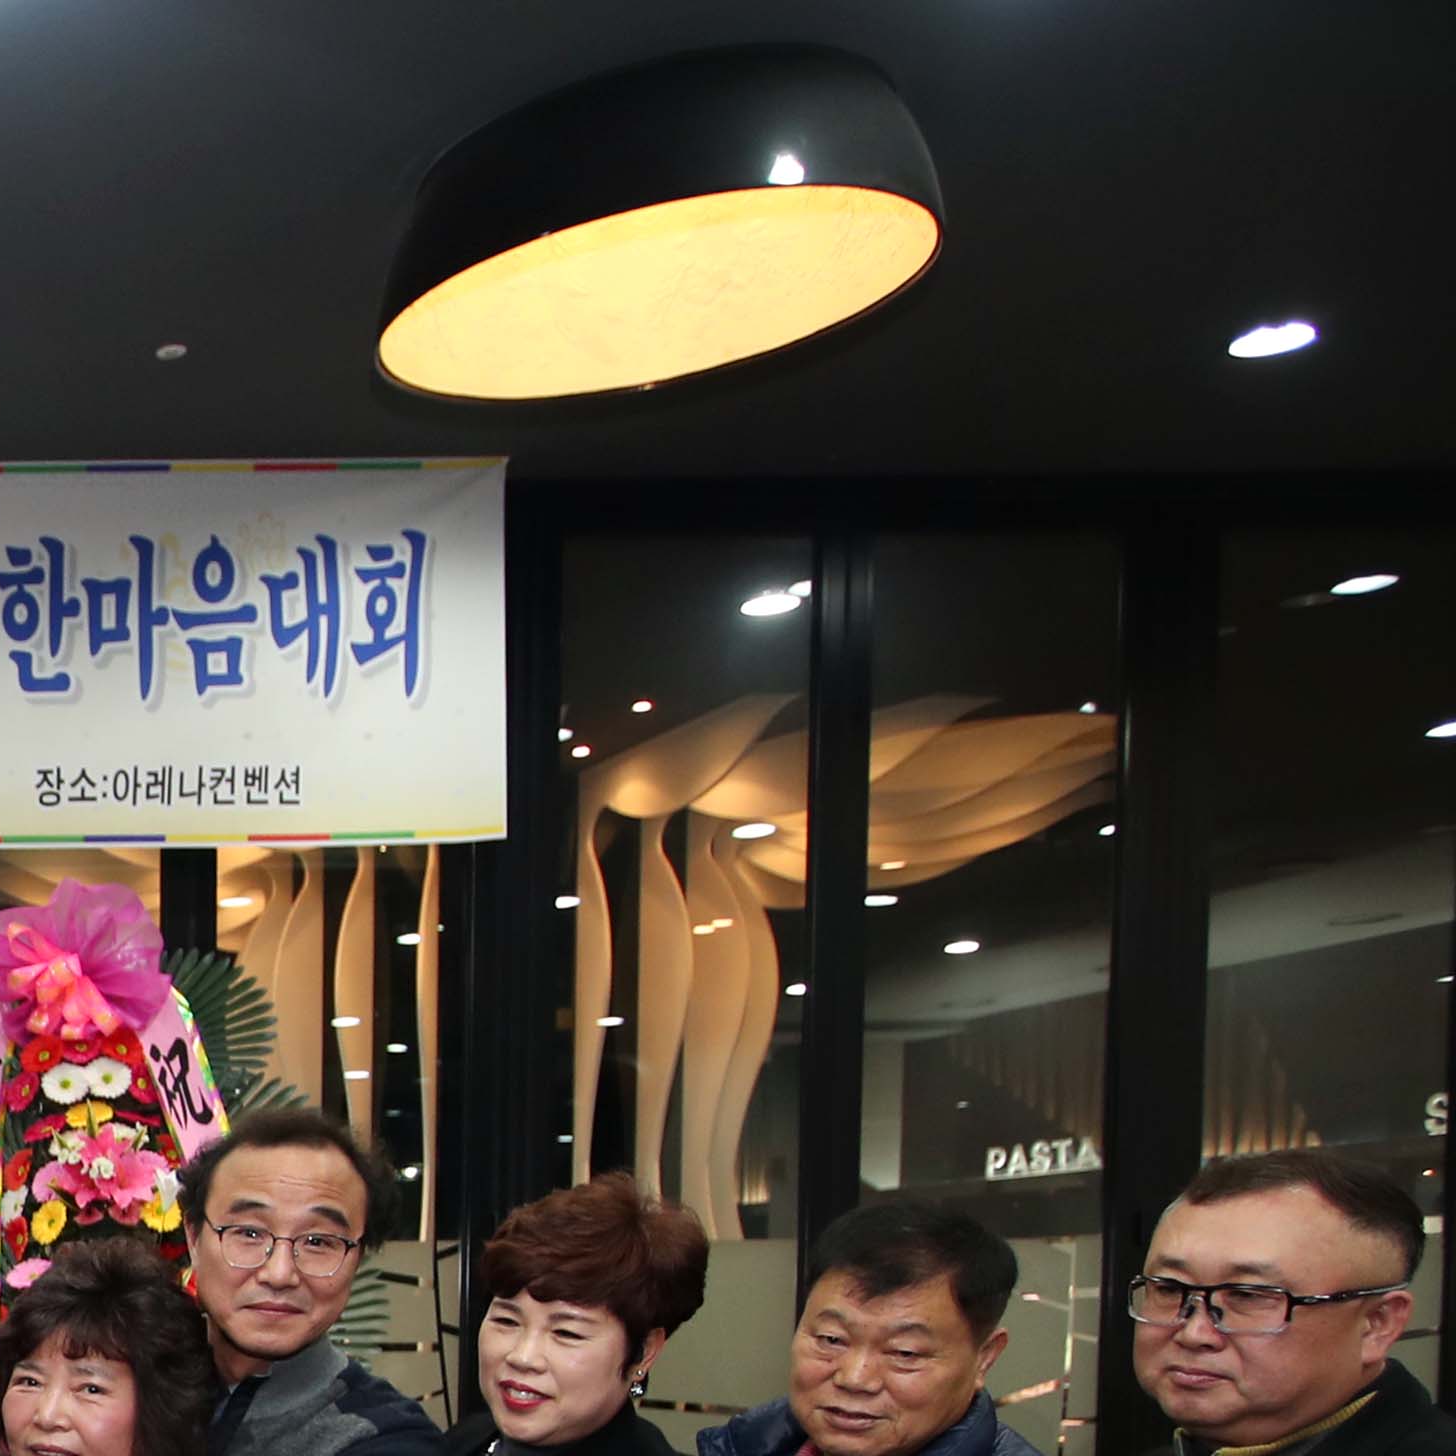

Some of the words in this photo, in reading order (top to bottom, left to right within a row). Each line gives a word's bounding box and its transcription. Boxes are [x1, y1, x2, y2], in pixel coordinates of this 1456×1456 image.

[35, 761, 303, 807] 장소:아레나컨벤션
[148, 1036, 214, 1130] 祝
[983, 1136, 1104, 1182] PASTA
